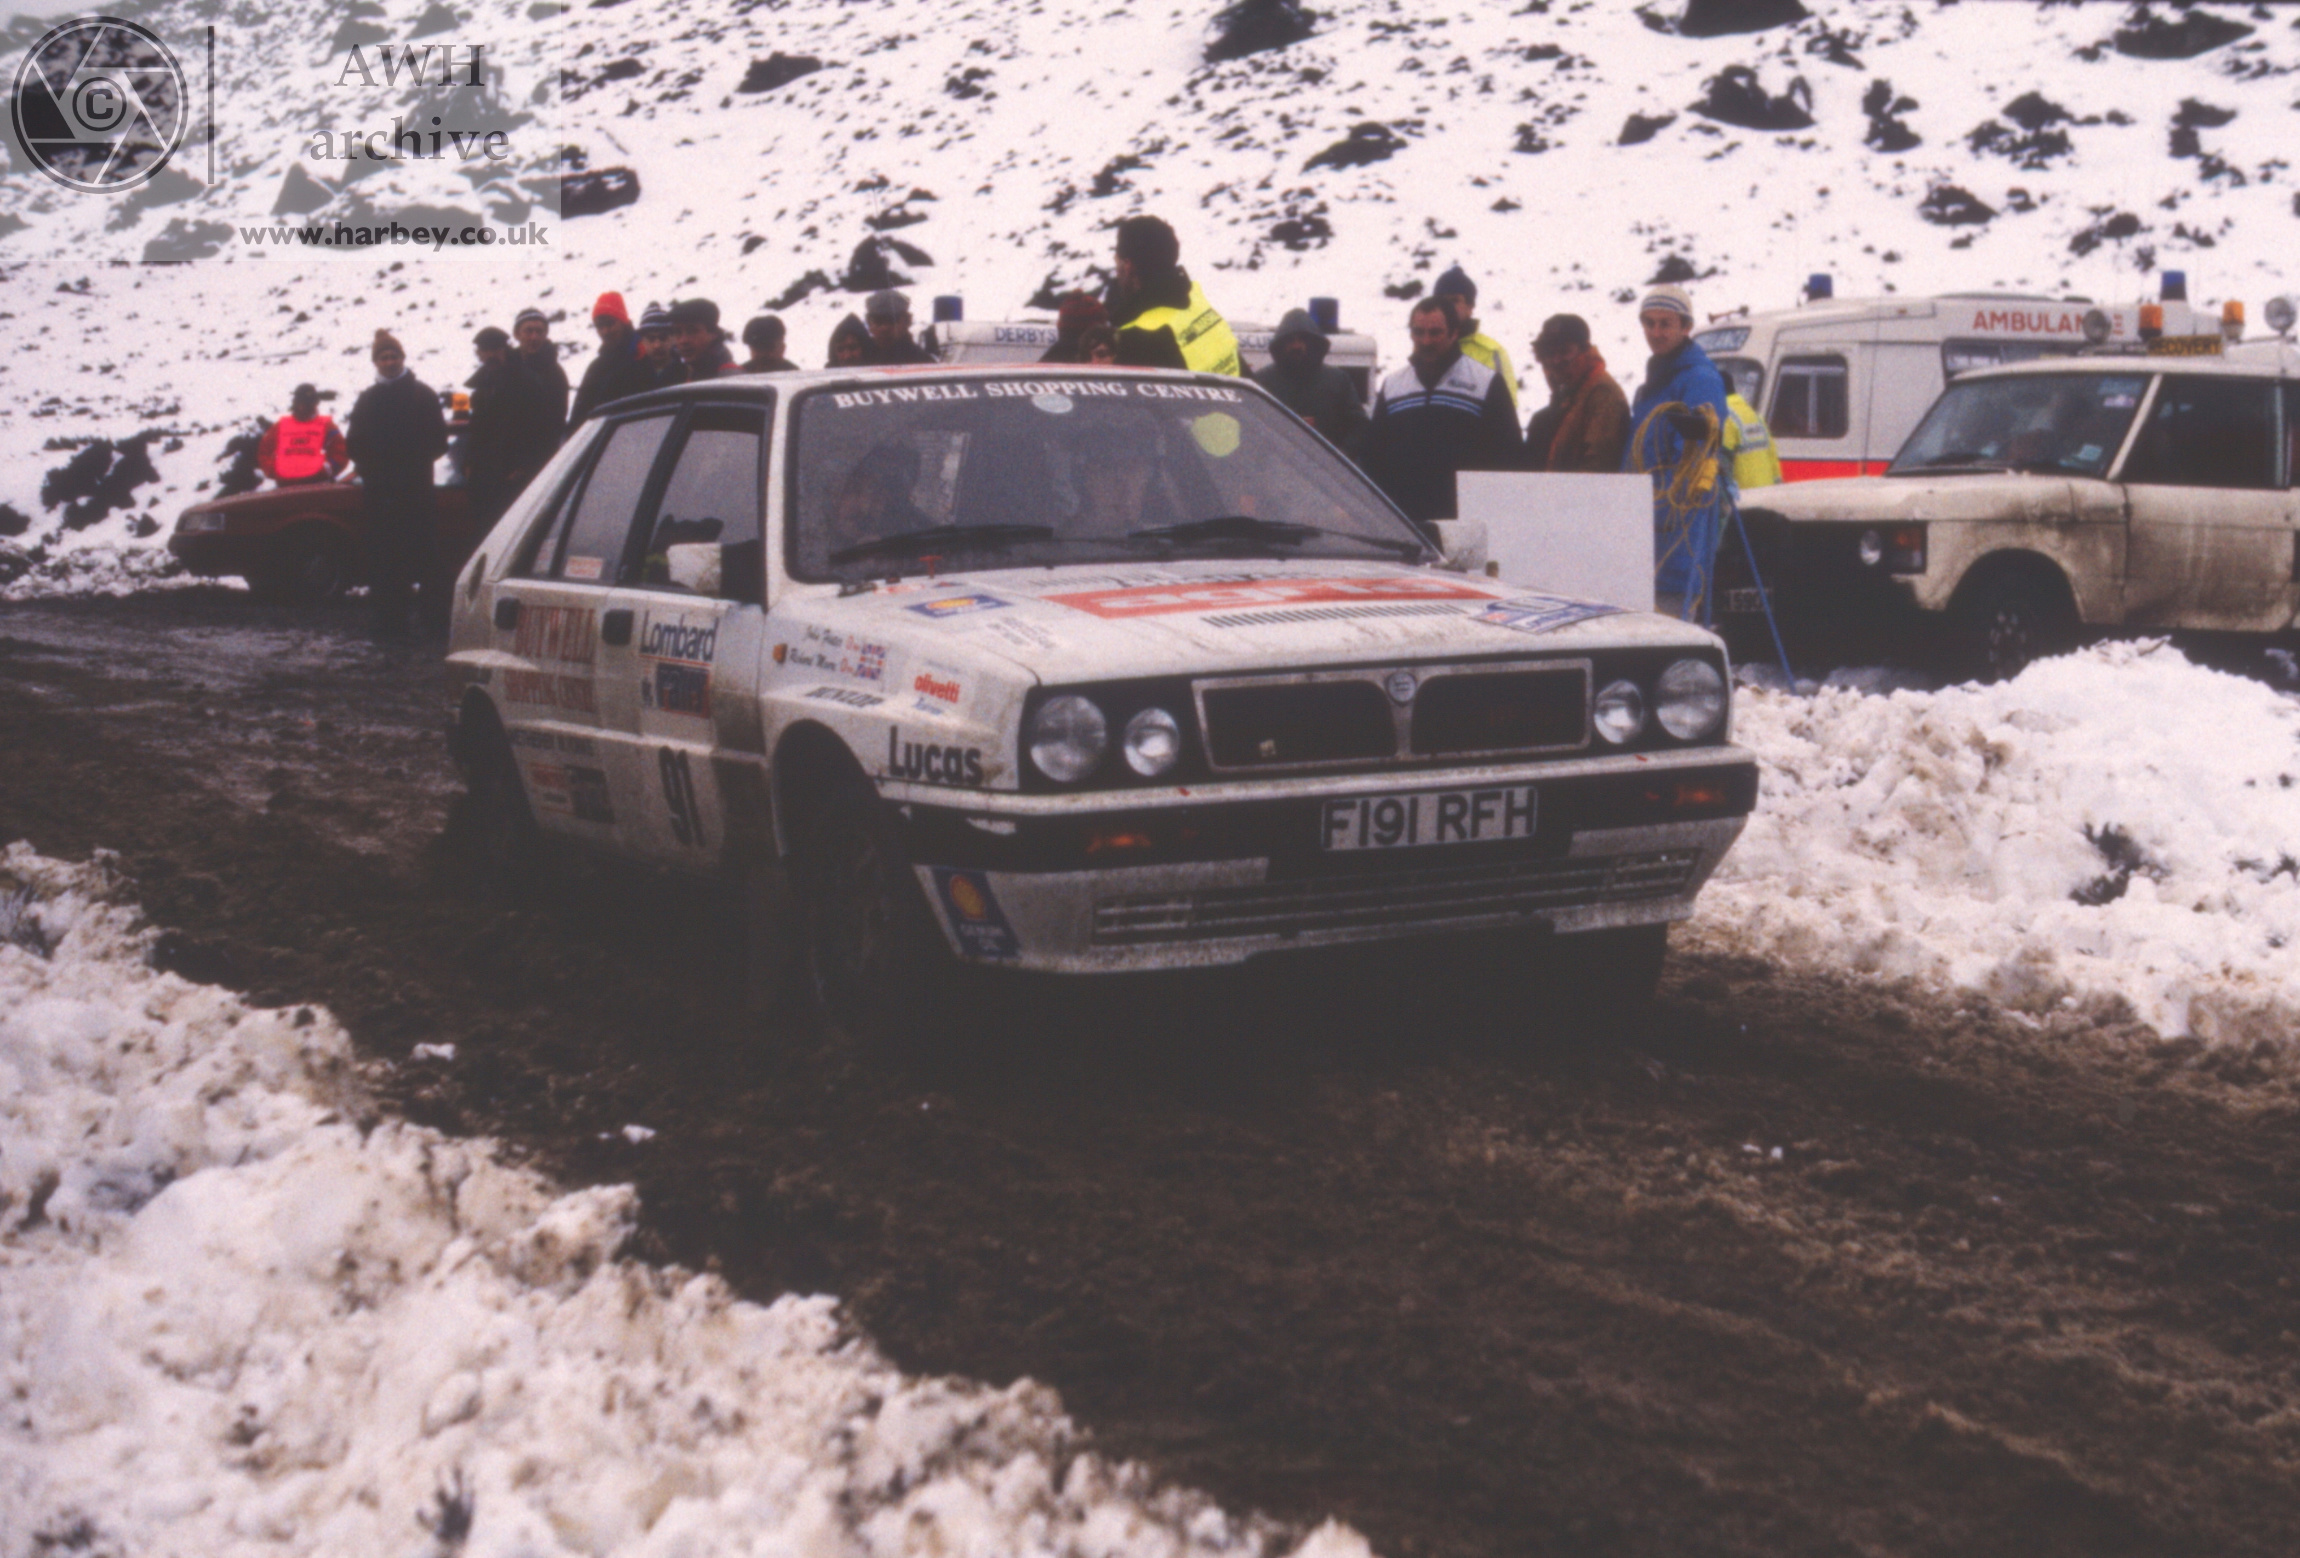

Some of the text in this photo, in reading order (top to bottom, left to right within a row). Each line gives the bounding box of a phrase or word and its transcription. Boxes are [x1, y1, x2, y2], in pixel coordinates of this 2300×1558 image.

[994, 327, 1058, 343] DERBYS
[1972, 310, 2126, 335] AMBULANE
[834, 382, 1242, 408] BUYWELL SHOPPING CENTRE
[640, 609, 719, 661] Lombard
[914, 673, 961, 704] olivetti
[889, 724, 984, 787] Lucas
[1323, 787, 1535, 849] F191 RFH
